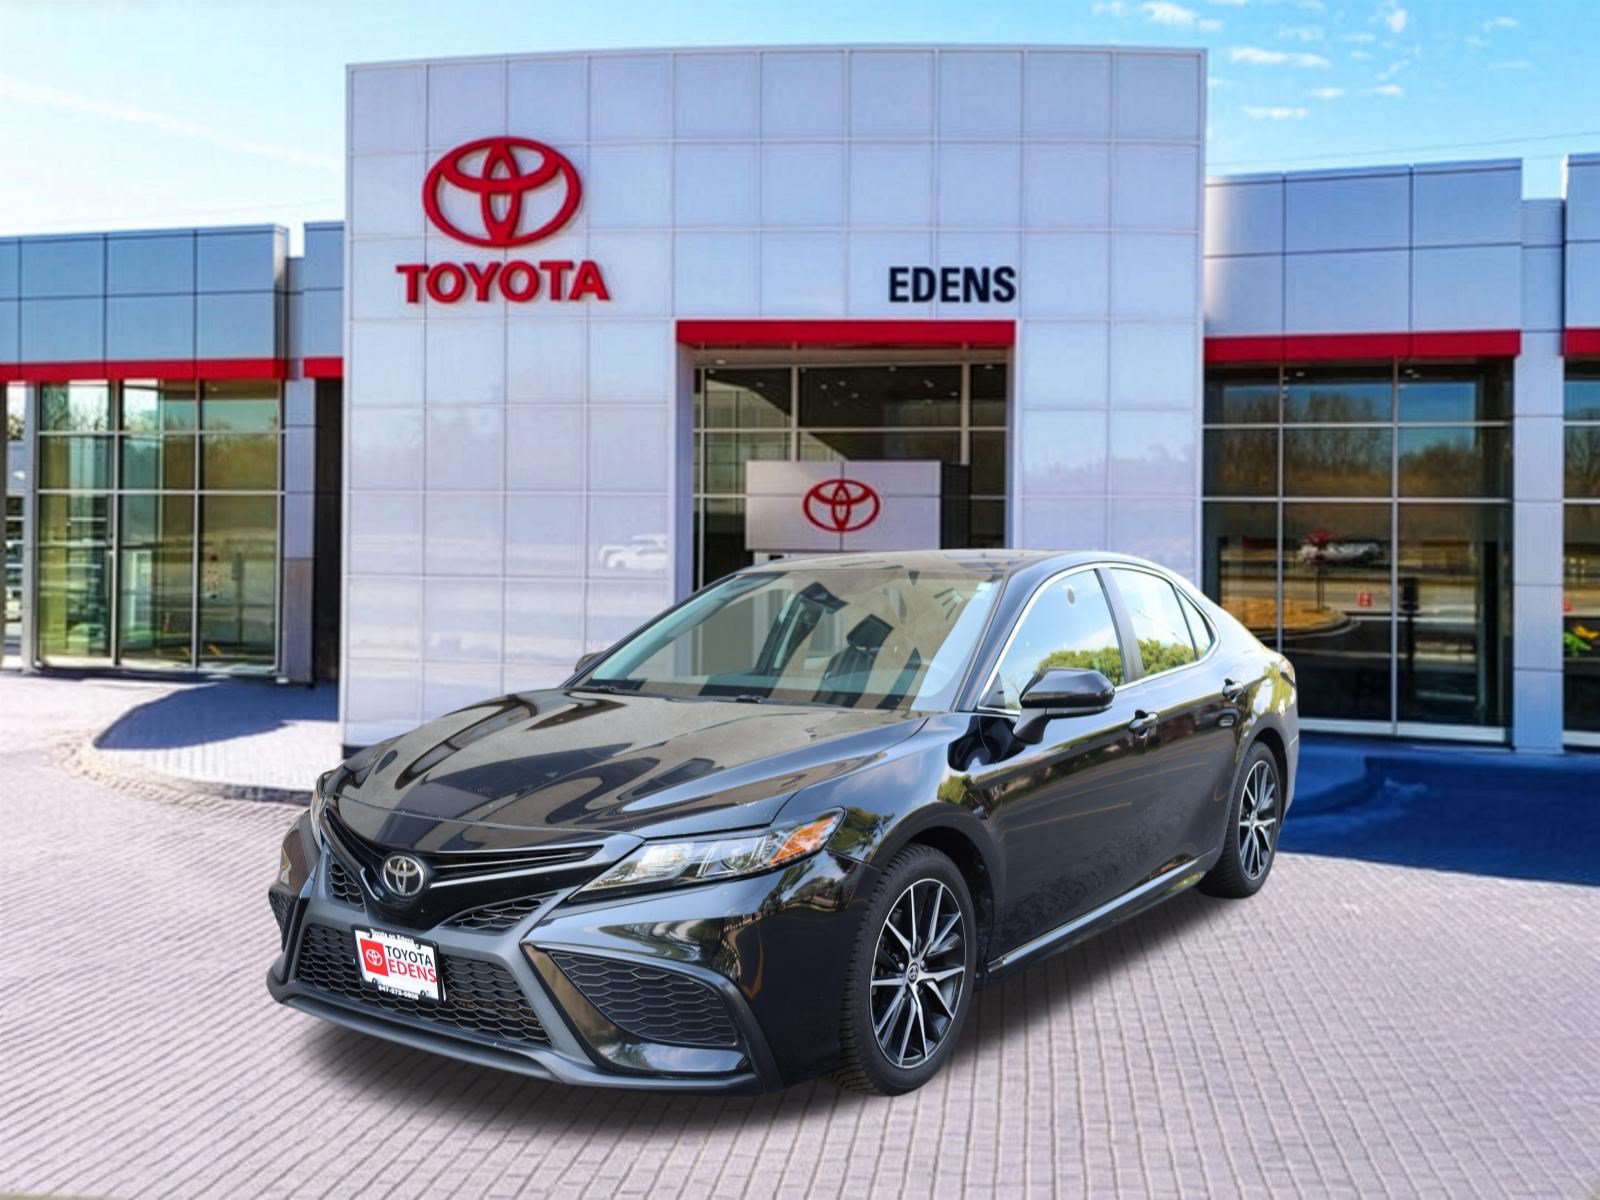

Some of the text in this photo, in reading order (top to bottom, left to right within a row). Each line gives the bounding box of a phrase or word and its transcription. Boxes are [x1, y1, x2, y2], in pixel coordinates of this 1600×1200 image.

[395, 259, 609, 303] TOYOTA
[889, 266, 1016, 303] EDENS
[385, 945, 433, 967] TOYOTA
[388, 959, 438, 983] EDENS
